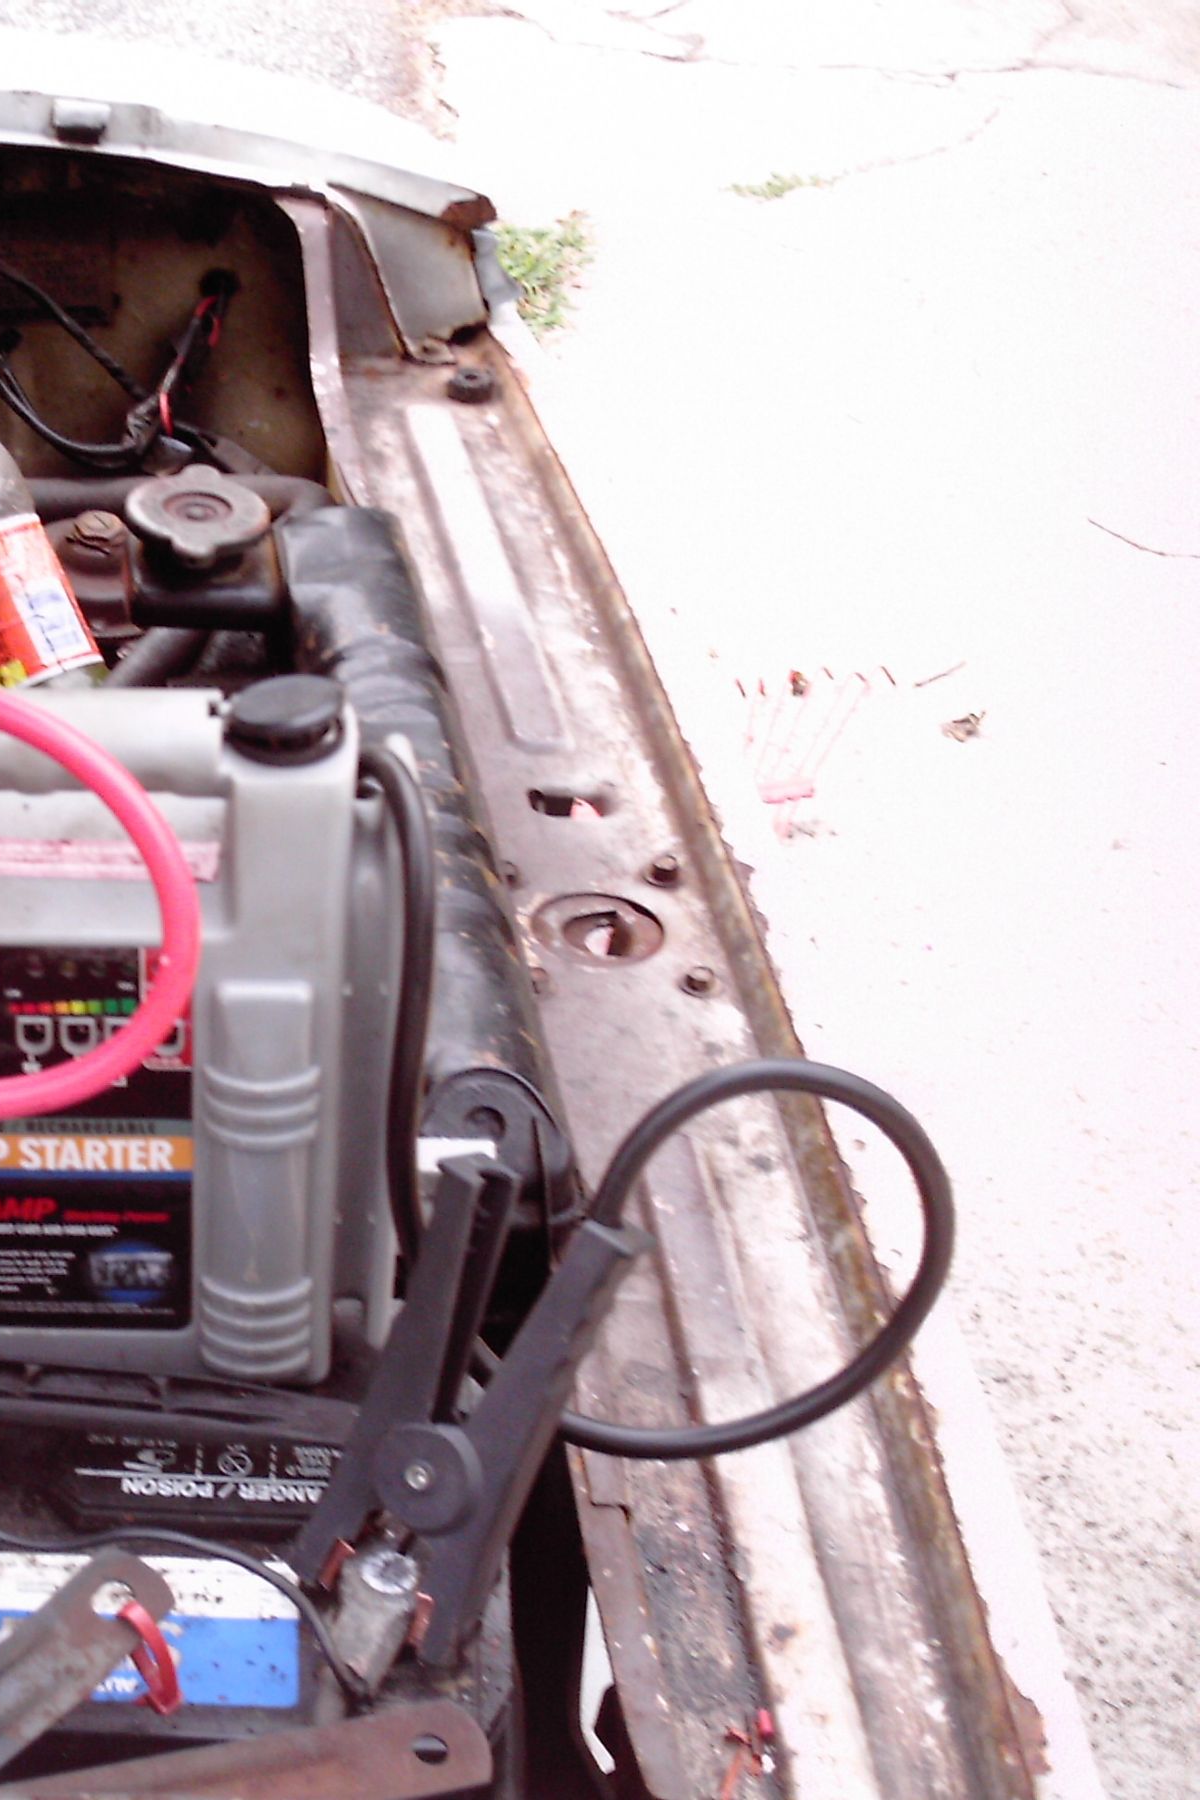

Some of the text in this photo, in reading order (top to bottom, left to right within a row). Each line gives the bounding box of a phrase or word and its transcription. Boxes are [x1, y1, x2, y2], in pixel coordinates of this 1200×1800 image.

[19, 1137, 175, 1171] STARTER
[121, 1477, 215, 1499] POISON
[238, 1481, 324, 1504] ANGER
